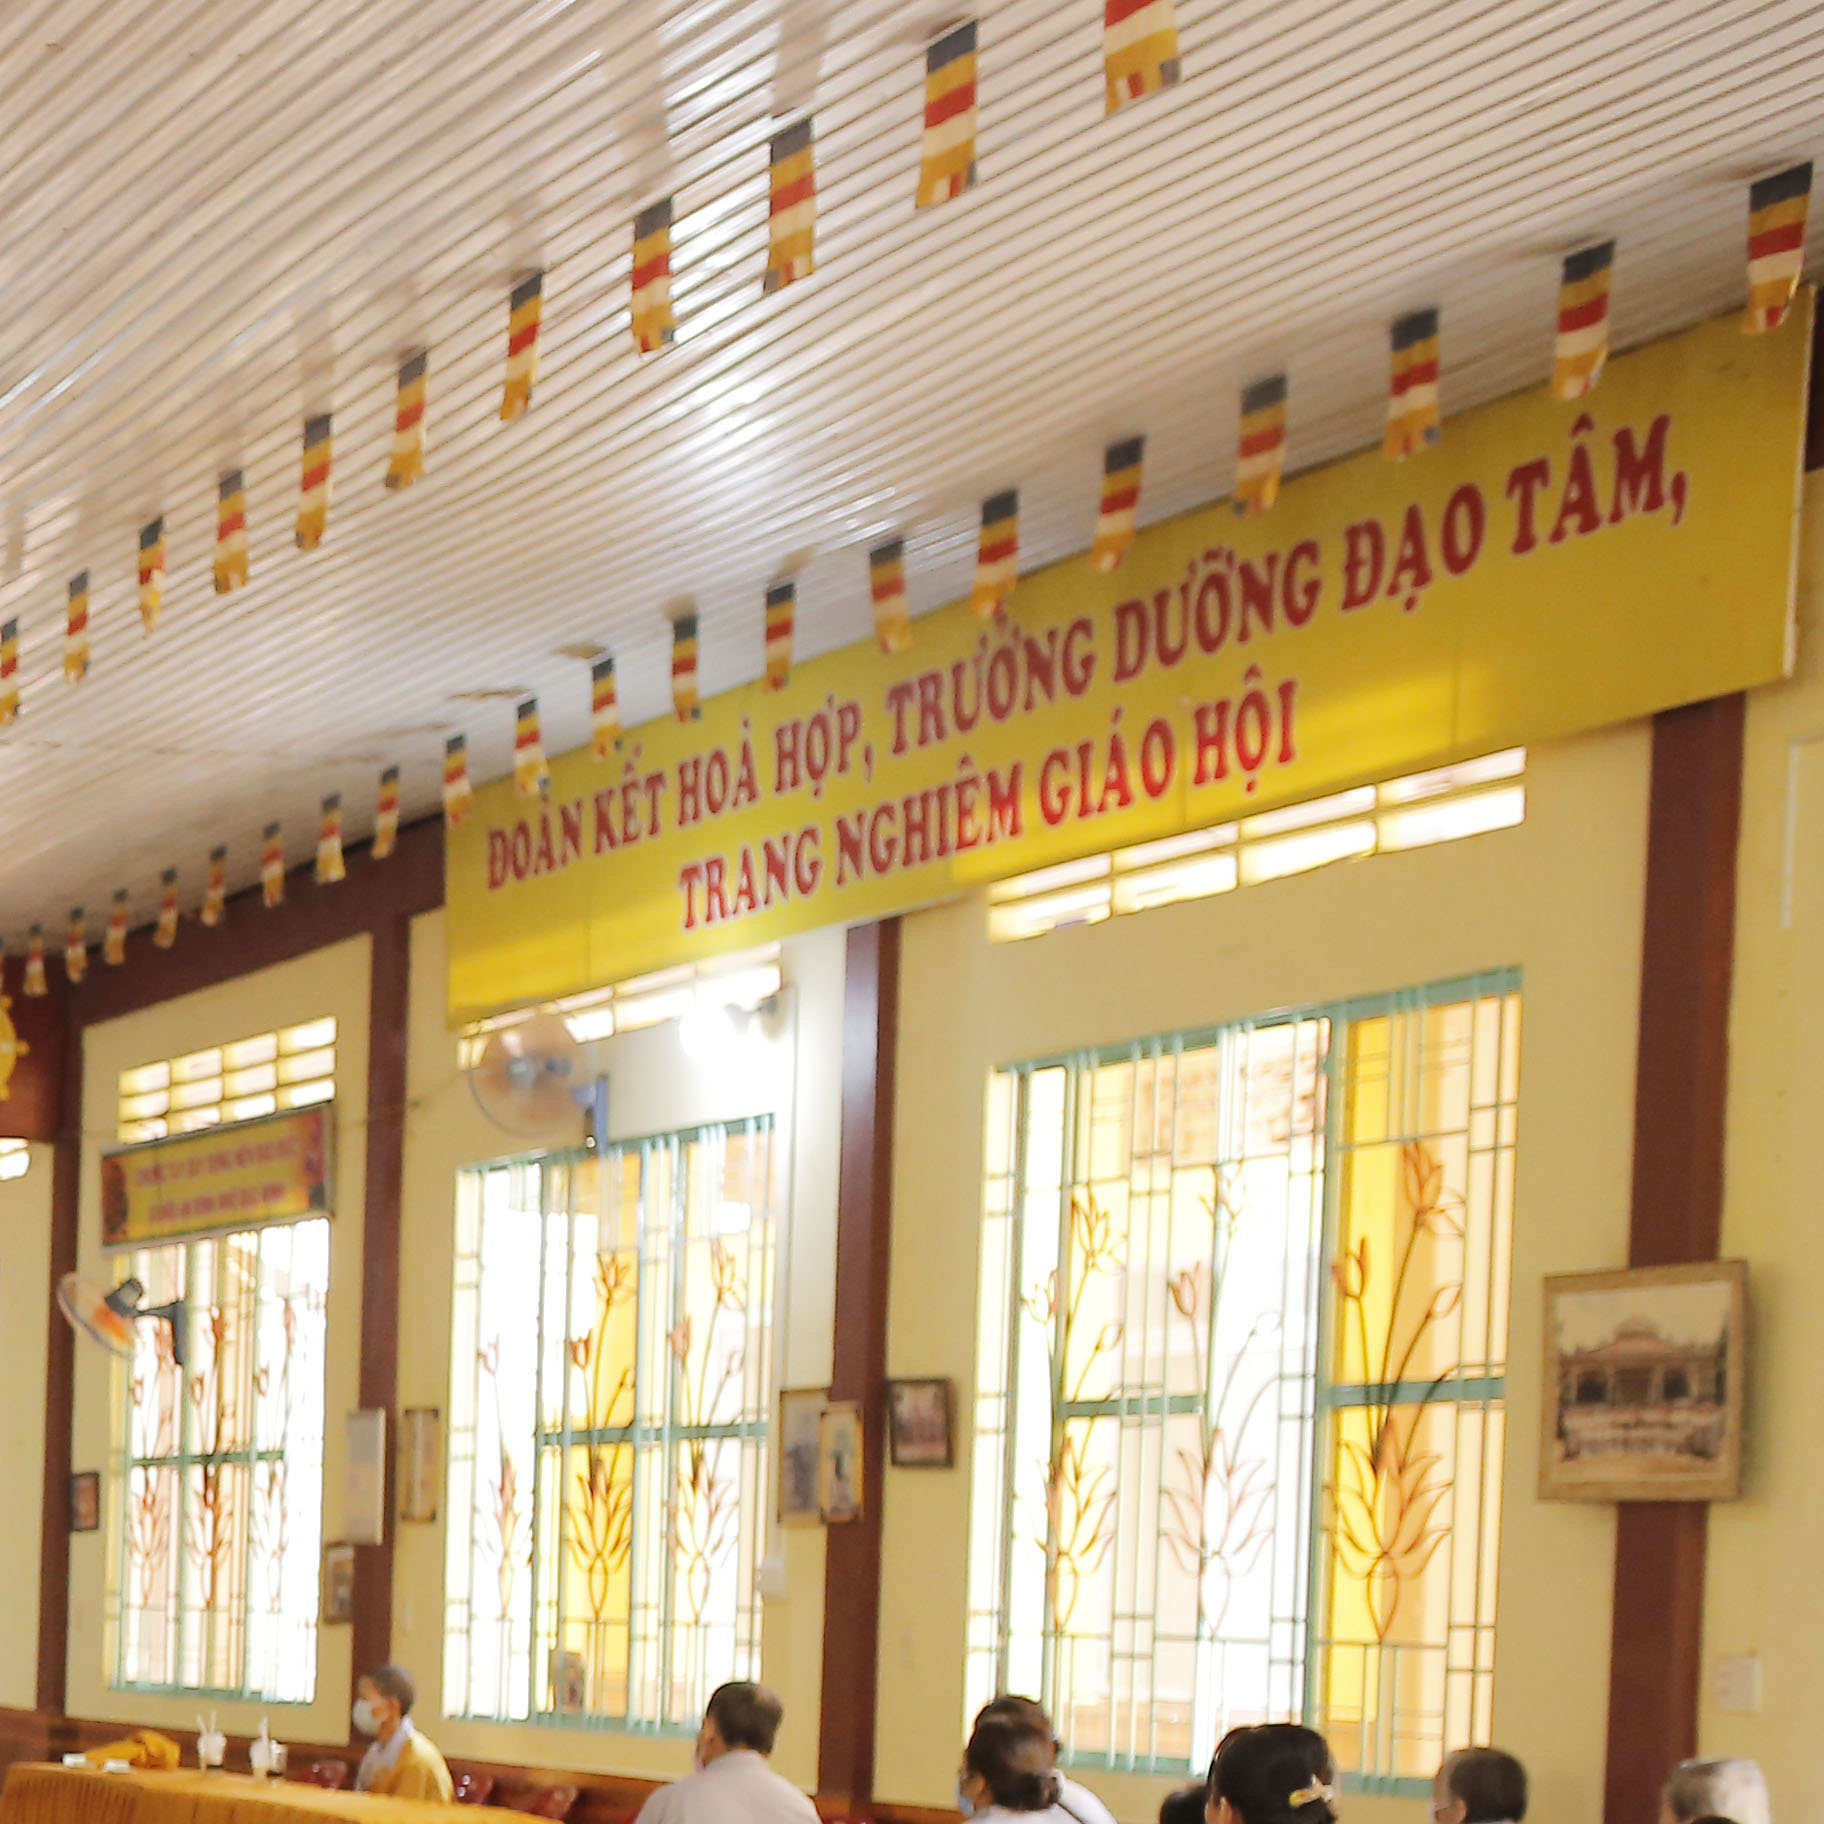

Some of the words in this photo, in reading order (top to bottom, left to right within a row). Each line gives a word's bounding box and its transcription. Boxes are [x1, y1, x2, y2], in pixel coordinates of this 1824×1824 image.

[593, 742, 667, 855] KẾT
[774, 693, 874, 798] HỢP,
[886, 610, 1096, 756] TRƯỞNG
[1113, 540, 1321, 682] DƯỠNG
[1340, 483, 1486, 613] ĐẠO
[1506, 412, 1687, 554] TÂM,
[679, 827, 821, 930] TRANG
[836, 754, 1024, 887] NGHIÊM
[1039, 706, 1176, 826] GIÁO
[1193, 663, 1298, 793] HỘI
